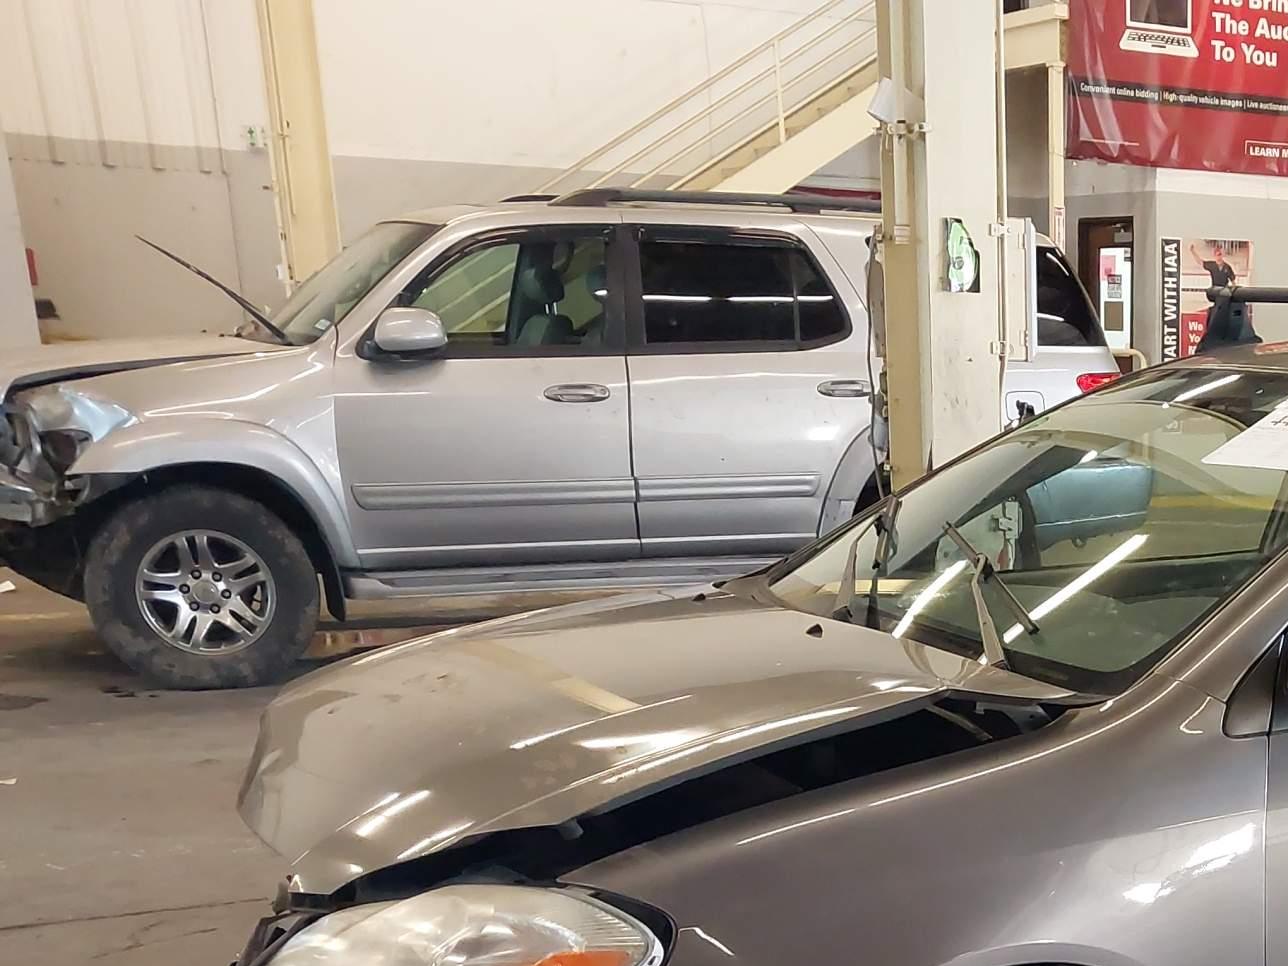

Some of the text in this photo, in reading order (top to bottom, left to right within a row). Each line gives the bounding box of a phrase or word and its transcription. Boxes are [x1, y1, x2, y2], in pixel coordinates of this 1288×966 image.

[1211, 11, 1249, 35] The
[1210, 39, 1278, 67] To You
[1080, 82, 1116, 95] Convenient
[1135, 89, 1159, 100] bidding
[1247, 100, 1258, 108] Live
[1249, 146, 1280, 158] LEARN
[1164, 243, 1177, 272] IAA
[1164, 276, 1177, 321] WITH
